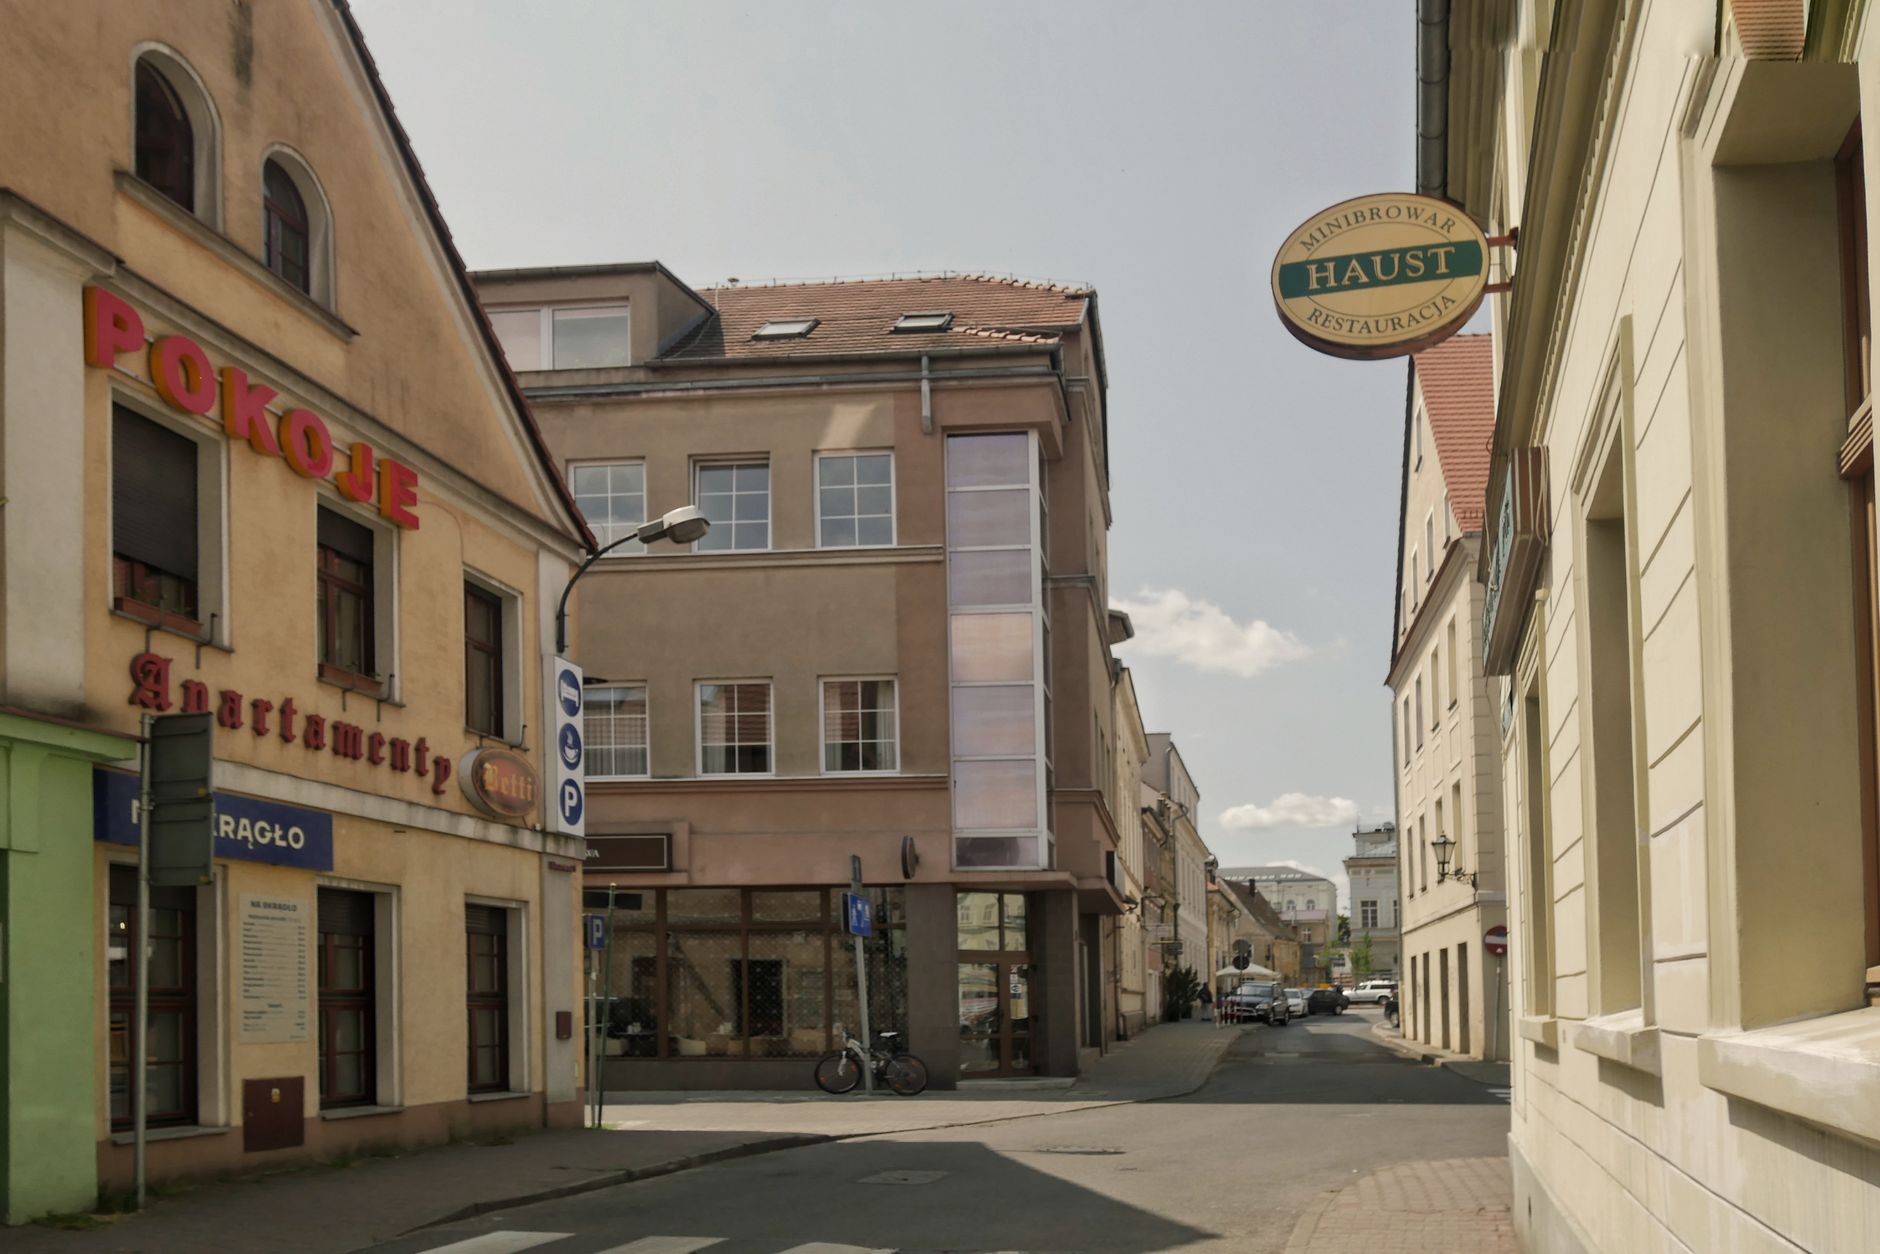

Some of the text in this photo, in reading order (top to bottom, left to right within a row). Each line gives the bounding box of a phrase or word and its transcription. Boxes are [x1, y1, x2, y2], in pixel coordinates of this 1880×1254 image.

[1300, 205, 1457, 252] MINIBROWAR
[1306, 247, 1456, 290] HAUST
[1307, 294, 1457, 334] RESTAURACJA
[84, 286, 421, 530] POKOJE
[564, 784, 578, 817] P
[592, 918, 603, 945] P
